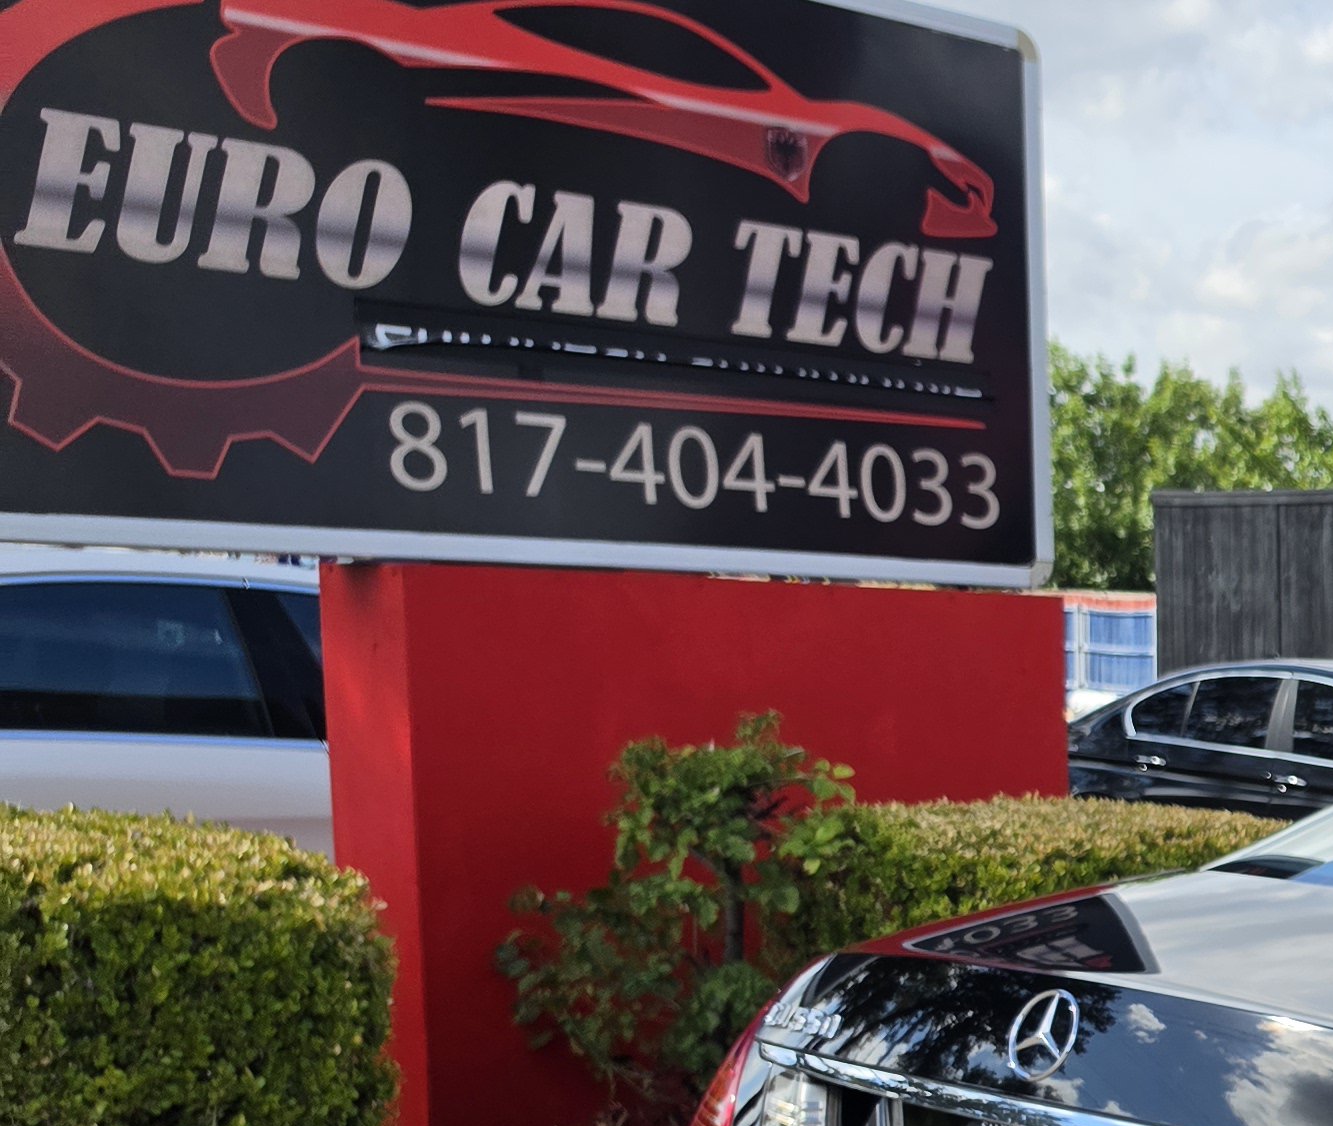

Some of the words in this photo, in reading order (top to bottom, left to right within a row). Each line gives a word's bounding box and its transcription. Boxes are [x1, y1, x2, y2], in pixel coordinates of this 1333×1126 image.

[12, 106, 412, 291] EURO
[457, 180, 694, 326] CAR
[731, 218, 993, 364] TECH
[387, 400, 1002, 530] 817-404-4033
